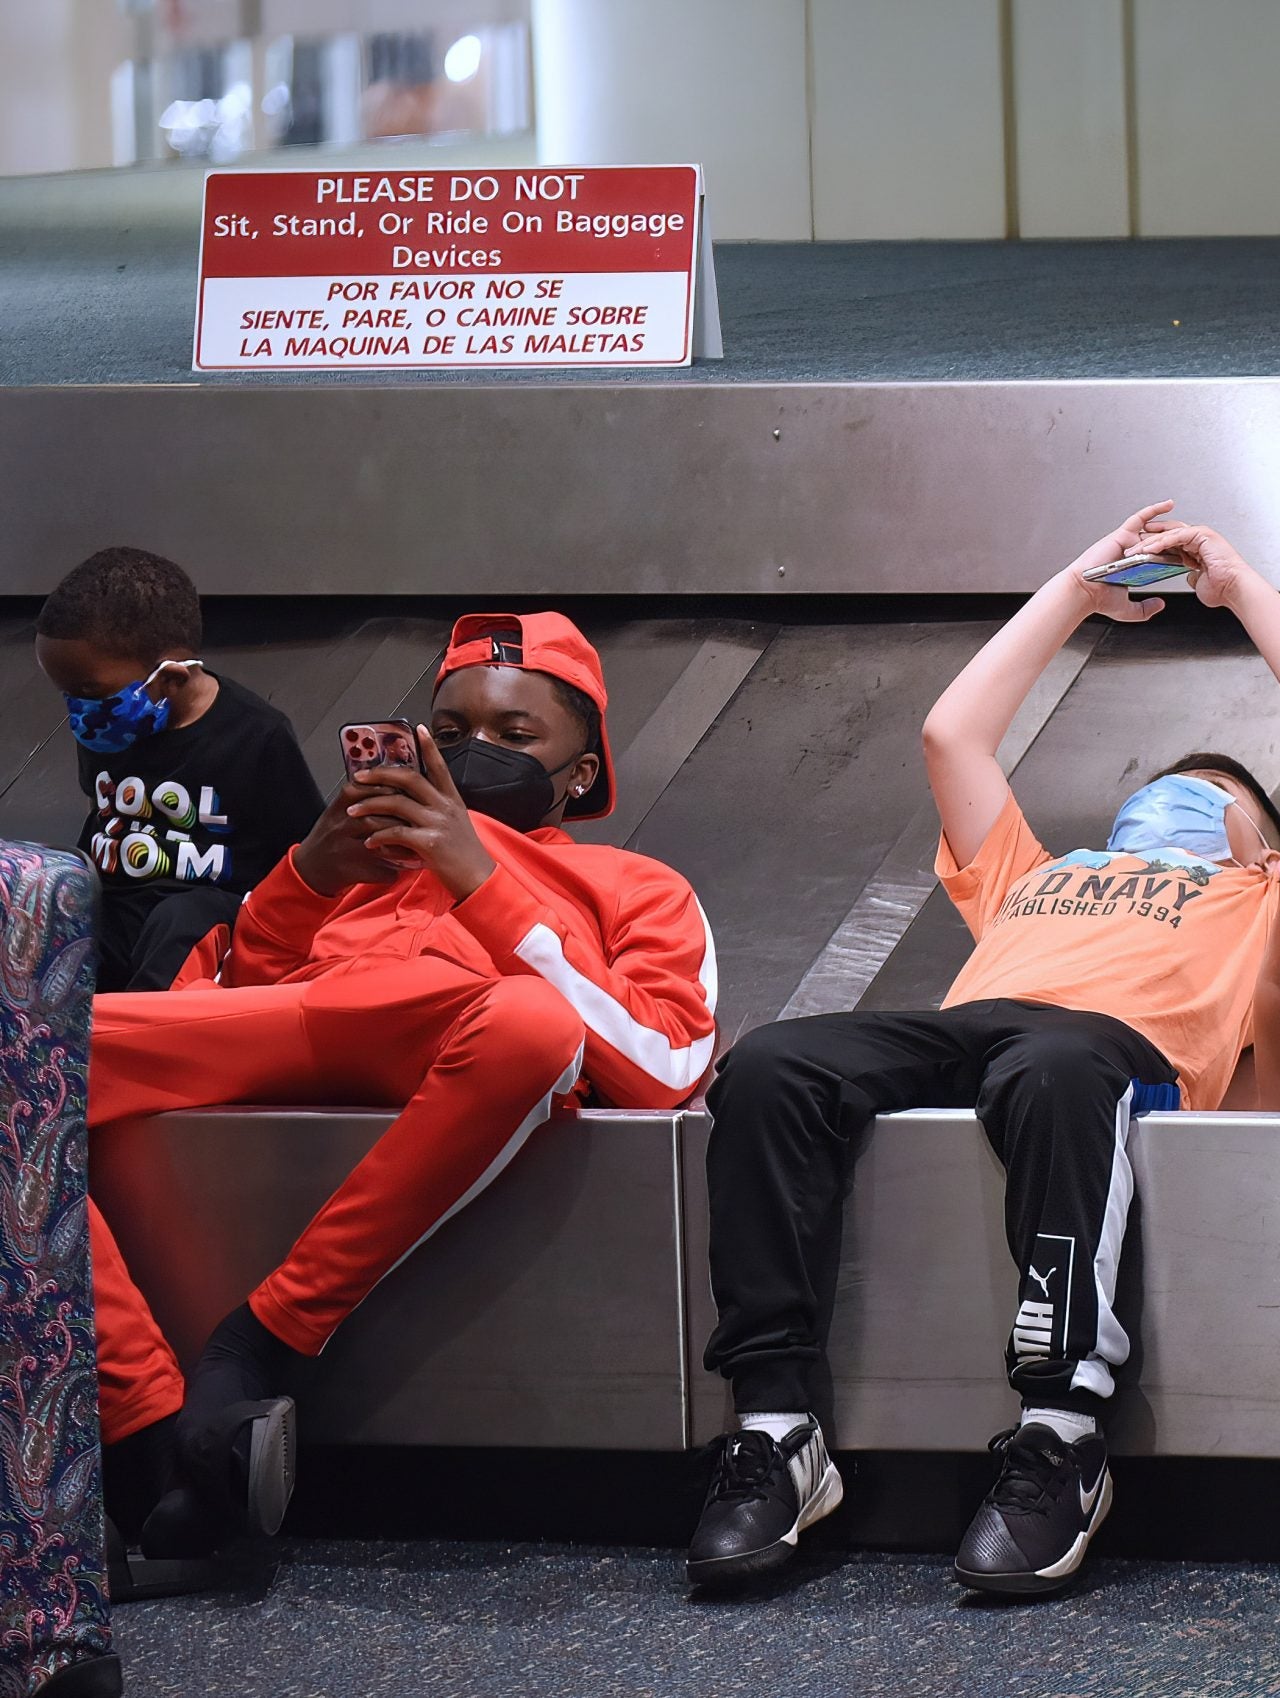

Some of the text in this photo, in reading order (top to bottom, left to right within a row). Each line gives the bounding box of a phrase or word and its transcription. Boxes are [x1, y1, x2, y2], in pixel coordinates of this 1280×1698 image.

[317, 175, 584, 203] PLEASE DO NOT
[213, 210, 684, 240] Sit, Stand, Or Ride On Baggage
[392, 244, 502, 268] Devices
[327, 279, 564, 301] POR FAVOR NO SE
[239, 305, 648, 331] SIENTE, PARE, O CAMINE SOBRE
[239, 333, 645, 359] LA MAQUINA DE LAS MALETAS
[95, 770, 231, 828] COOL
[91, 832, 228, 881] MOM
[1076, 873, 1203, 911] NAVY
[1127, 900, 1182, 929] 1994
